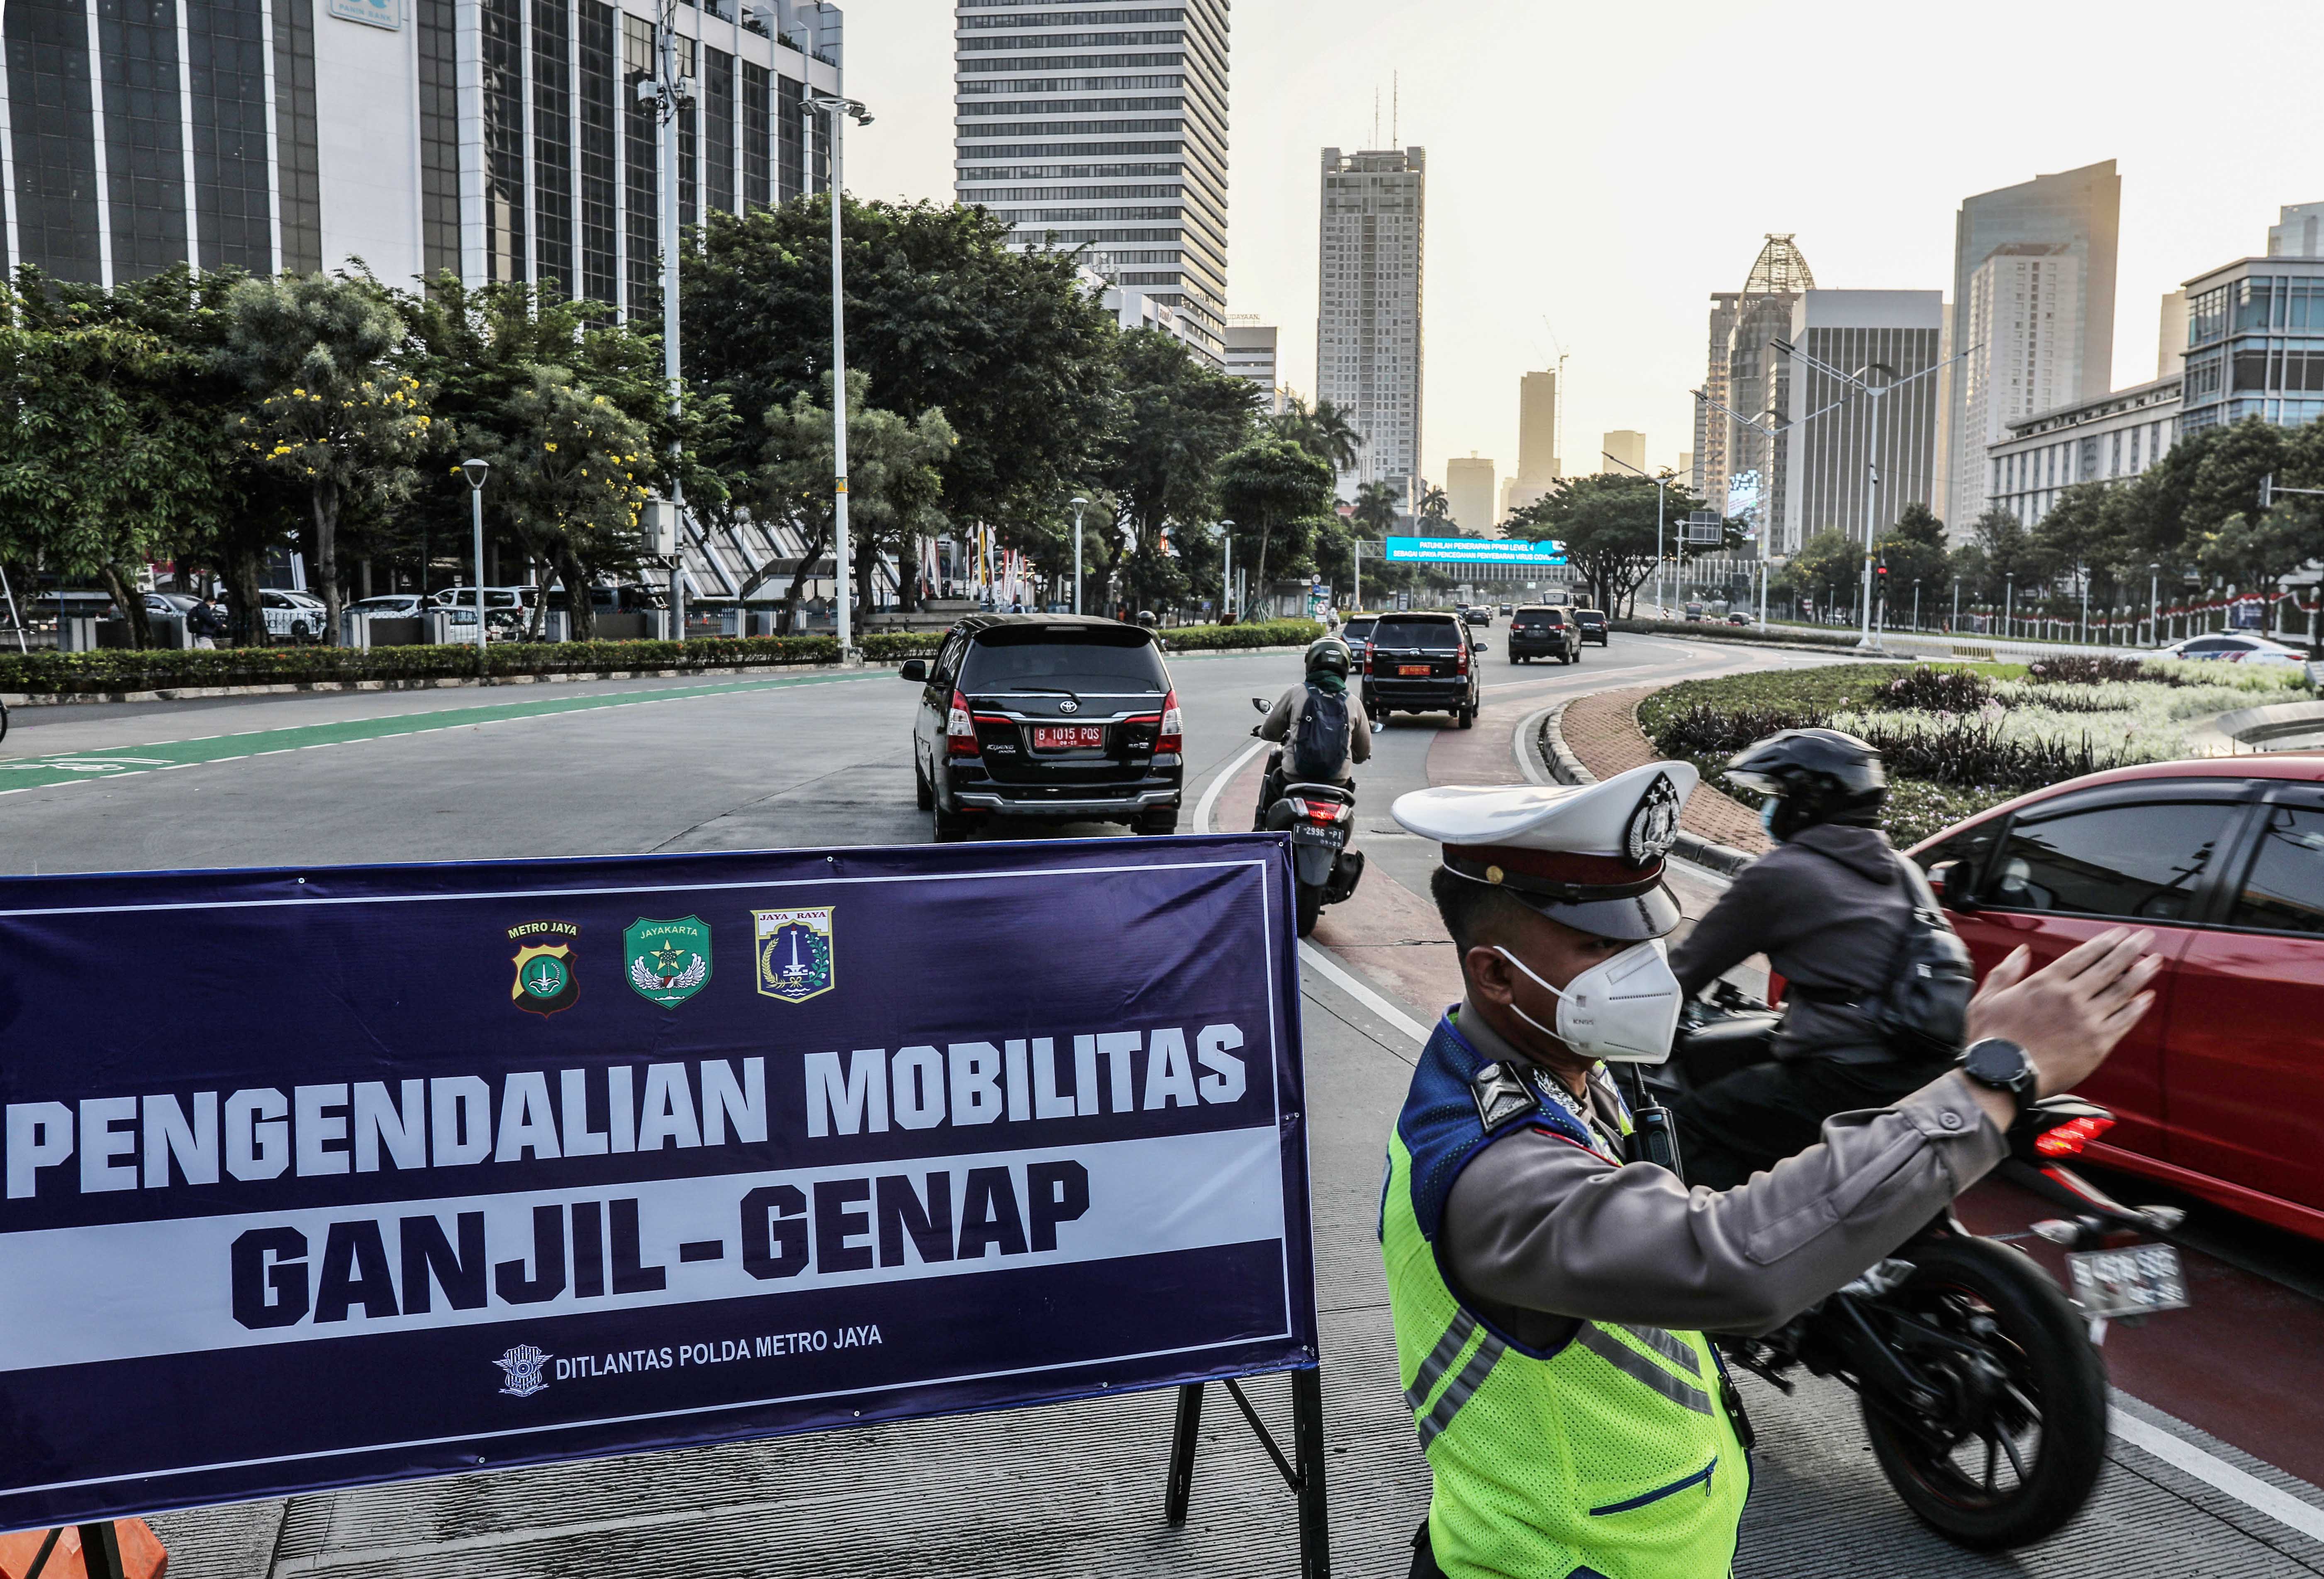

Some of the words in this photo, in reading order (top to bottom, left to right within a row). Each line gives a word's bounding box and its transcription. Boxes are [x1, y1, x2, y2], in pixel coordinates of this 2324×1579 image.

[339, 3, 365, 15] PANIN
[368, 10, 392, 22] BANK
[1454, 542, 1491, 551] PENERAPAN
[1039, 729, 1045, 741] B
[1053, 727, 1075, 740] 1015
[1081, 728, 1099, 740] PQS
[1296, 825, 1301, 833] T
[1306, 827, 1325, 837] 2996
[508, 922, 548, 939] METRO
[551, 922, 577, 936] JAYA
[640, 926, 698, 939] JAYAKARTA
[6, 1056, 768, 1199] PENGENDALIAN
[804, 1023, 1246, 1138] MOBILITAS
[556, 1347, 672, 1380] DITLANTAS
[680, 1339, 751, 1367] POLDA
[756, 1330, 828, 1357] METRO
[833, 1324, 883, 1350] JAYA
